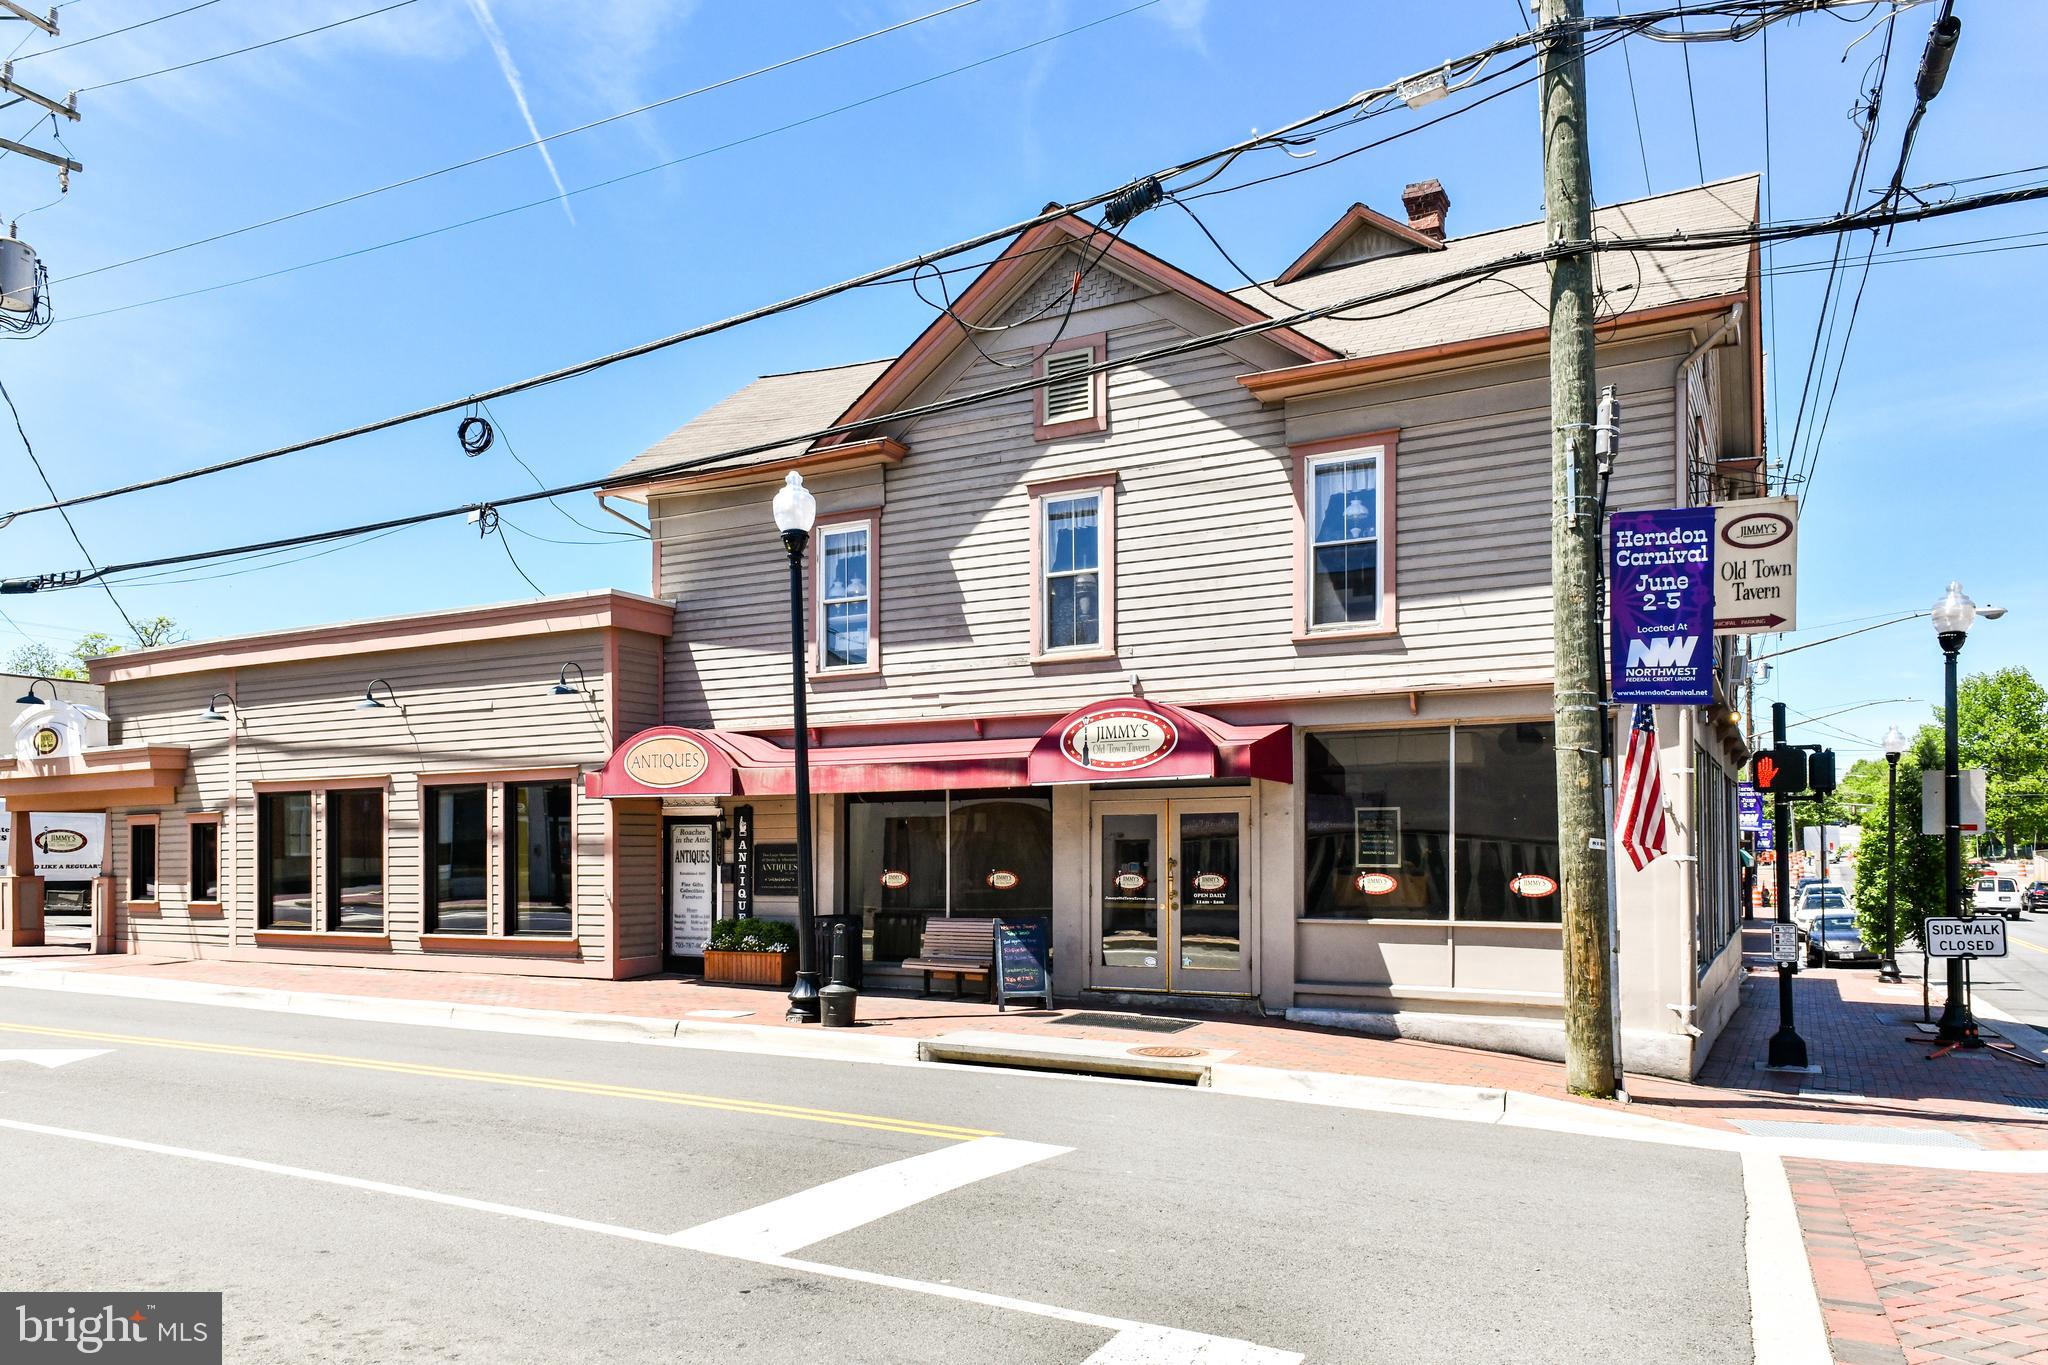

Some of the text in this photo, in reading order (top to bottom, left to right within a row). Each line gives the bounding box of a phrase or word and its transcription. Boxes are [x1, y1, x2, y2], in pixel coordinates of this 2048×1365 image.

[1616, 527, 1708, 547] Herndon
[1740, 523, 1777, 538] JIMMY'S
[1616, 545, 1708, 566] Carnival
[1721, 559, 1792, 581] Old Town
[1635, 574, 1689, 592] June
[1732, 582, 1780, 601] Tavern
[1643, 592, 1681, 611] 2-5
[1637, 623, 1688, 634] Located At
[1626, 635, 1699, 668] NW
[1625, 667, 1698, 677] NORTHWEST
[1616, 689, 1708, 697] www.HerndonCarnival.net
[1096, 723, 1149, 742] JIMMY'S
[1092, 742, 1151, 754] Old Town Tavern
[631, 752, 699, 770] ANTIQUES
[680, 828, 706, 836] Roaches
[675, 850, 711, 865] ANTIQUES
[762, 863, 799, 872] ANTIQUES
[1932, 925, 2000, 935] SIDEWALK
[1940, 940, 1994, 951] CLOSED
